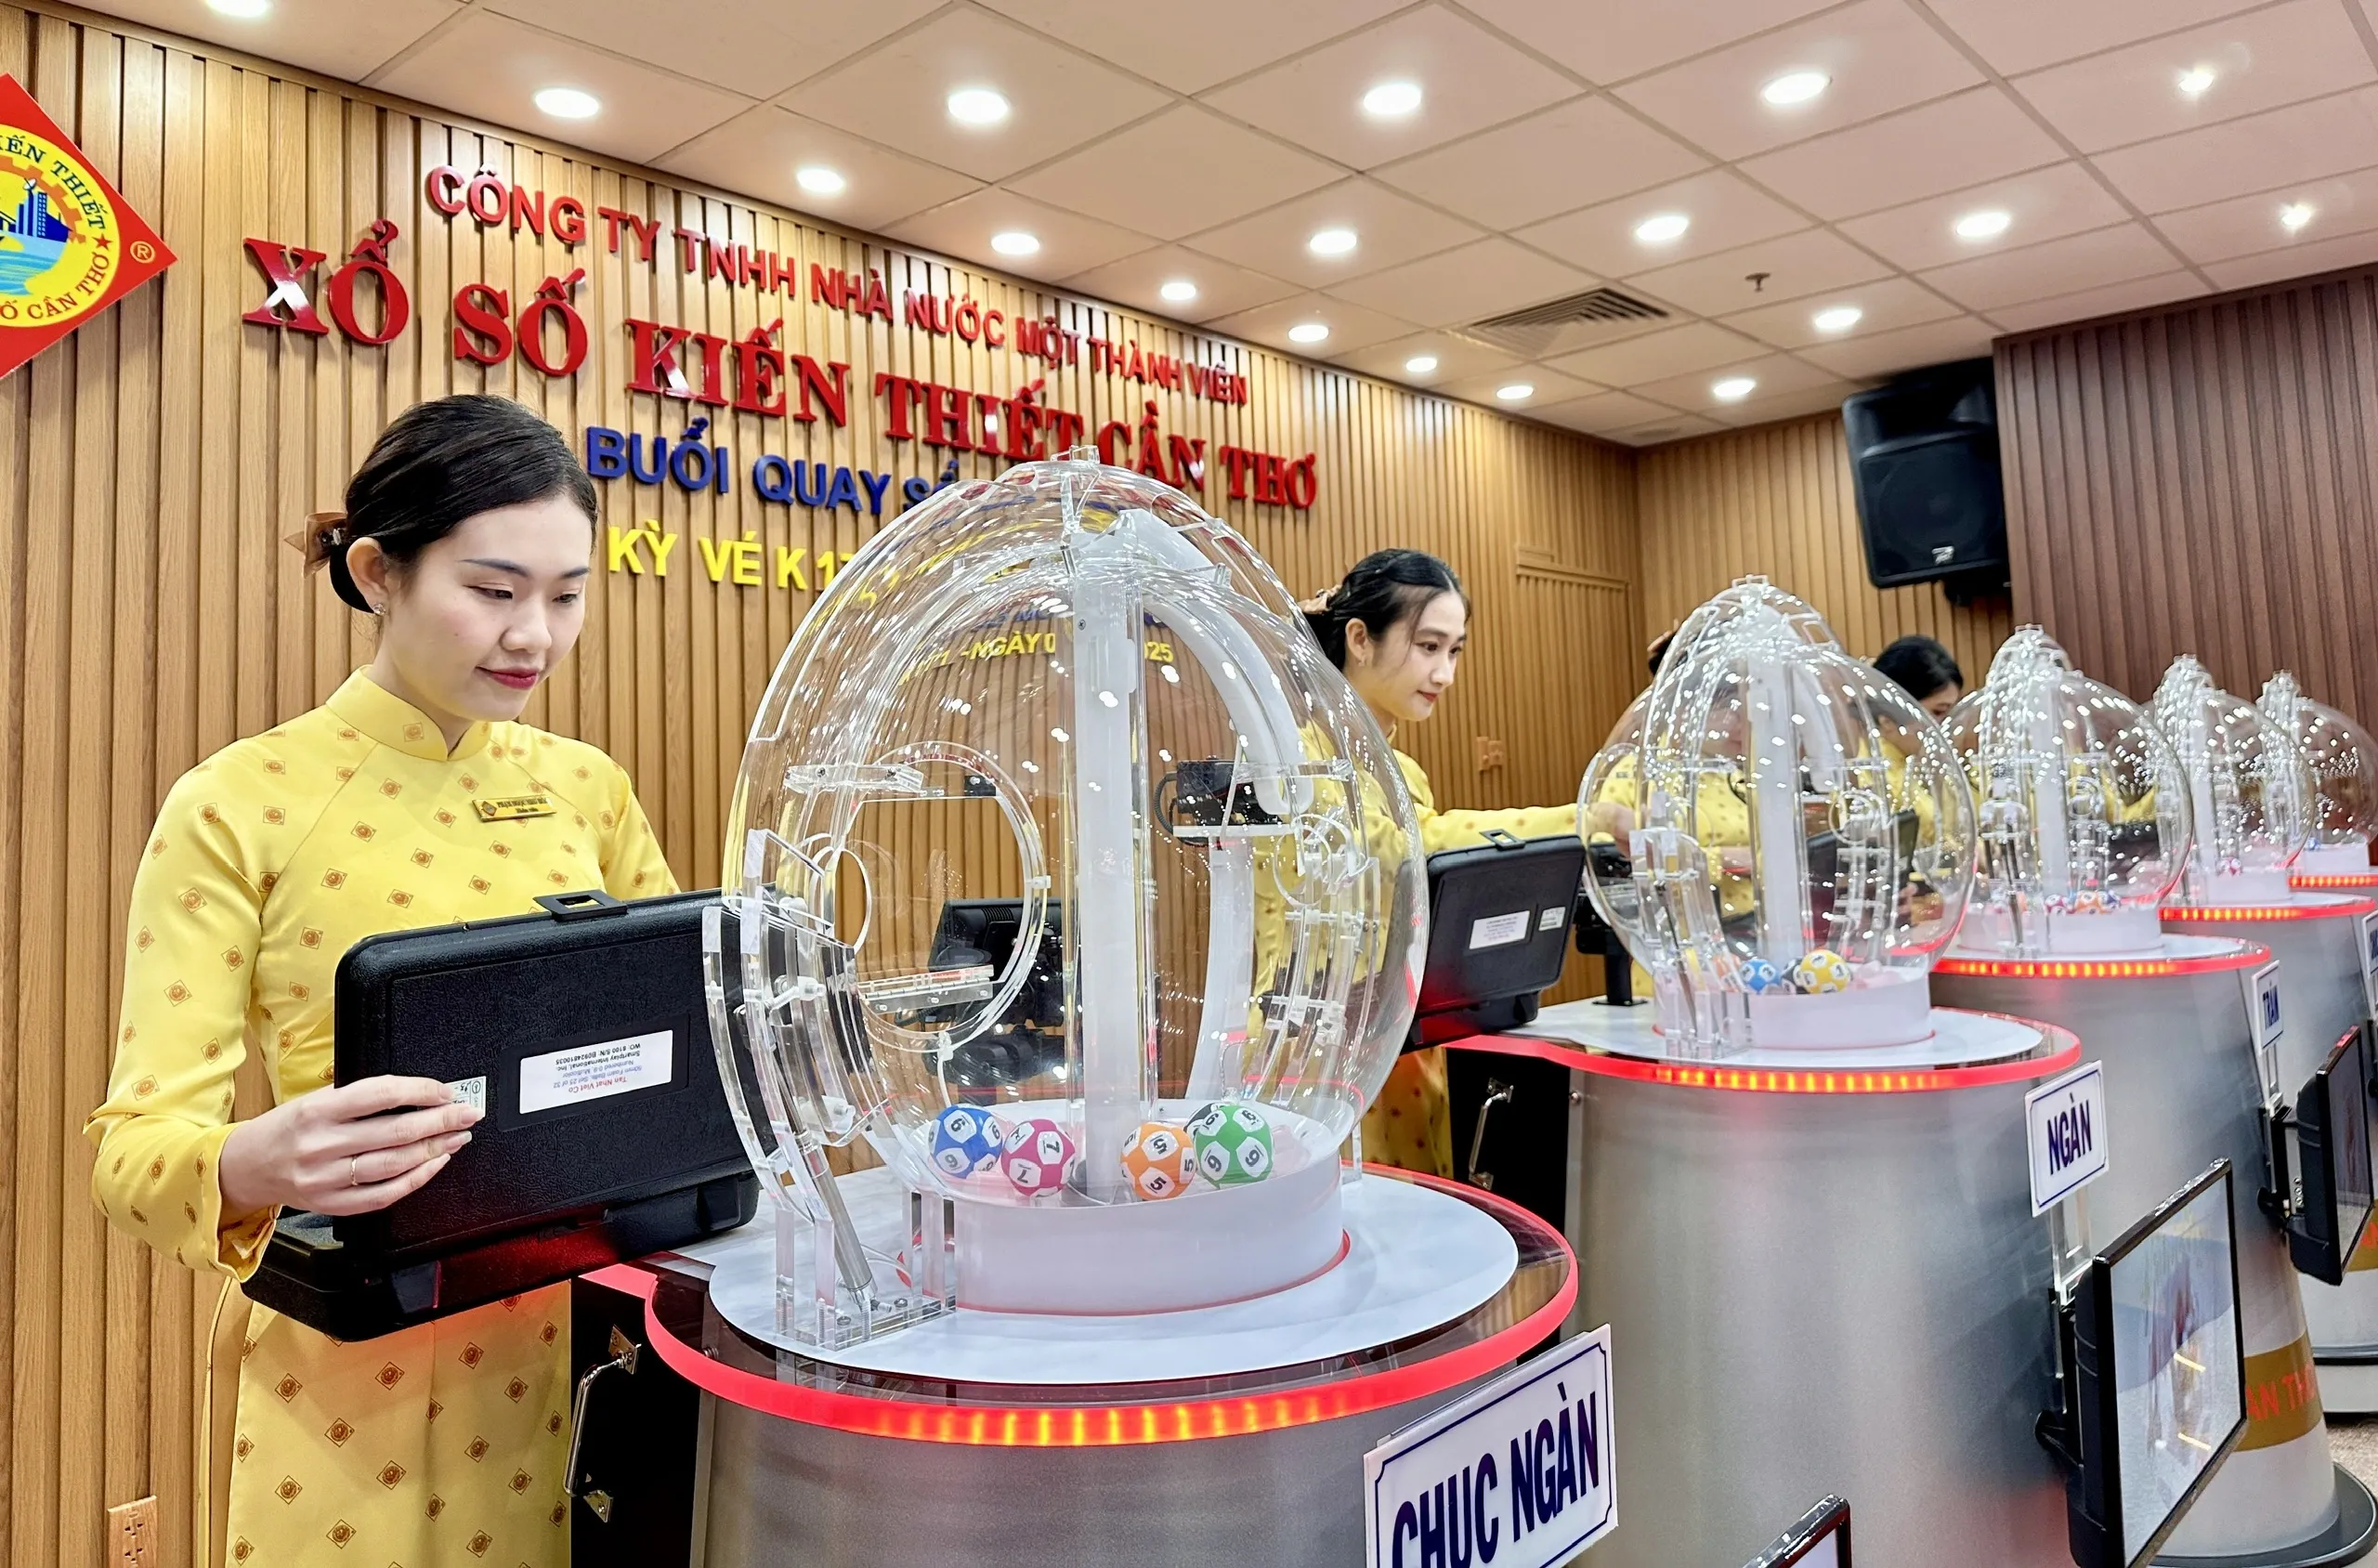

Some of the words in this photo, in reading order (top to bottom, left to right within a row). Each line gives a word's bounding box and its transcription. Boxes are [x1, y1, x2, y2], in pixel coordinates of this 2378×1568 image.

[50, 160, 108, 229] THIẾT
[26, 292, 78, 320] CẦN
[75, 252, 110, 296] THƠ
[427, 163, 587, 245] CÔNG
[597, 206, 661, 262] TY
[674, 226, 795, 297] TNHH
[811, 264, 894, 321] NHÀ
[905, 288, 1006, 347] NƯỚC
[1015, 316, 1081, 371] MỘT
[1087, 336, 1183, 391] THÀNH
[1186, 359, 1248, 405] VIÊN
[242, 216, 410, 346] XỔ
[452, 267, 590, 379] SỐ
[624, 317, 850, 427] KIẾN
[874, 372, 1085, 463] THIẾT
[1096, 399, 1206, 492] CẦN
[1220, 445, 1318, 510] THƠ
[586, 416, 729, 494] BUỔI
[752, 453, 892, 516] QUAY
[608, 518, 678, 576] KỲ
[699, 529, 762, 587] VÉ
[581, 1082, 594, 1091] Viet
[595, 1078, 612, 1087] Nhat
[604, 1060, 634, 1070] Numbered
[610, 1051, 640, 1061] Smartplay
[2046, 1091, 2093, 1175] NGÀN
[1509, 1381, 1600, 1543] NGÀN
